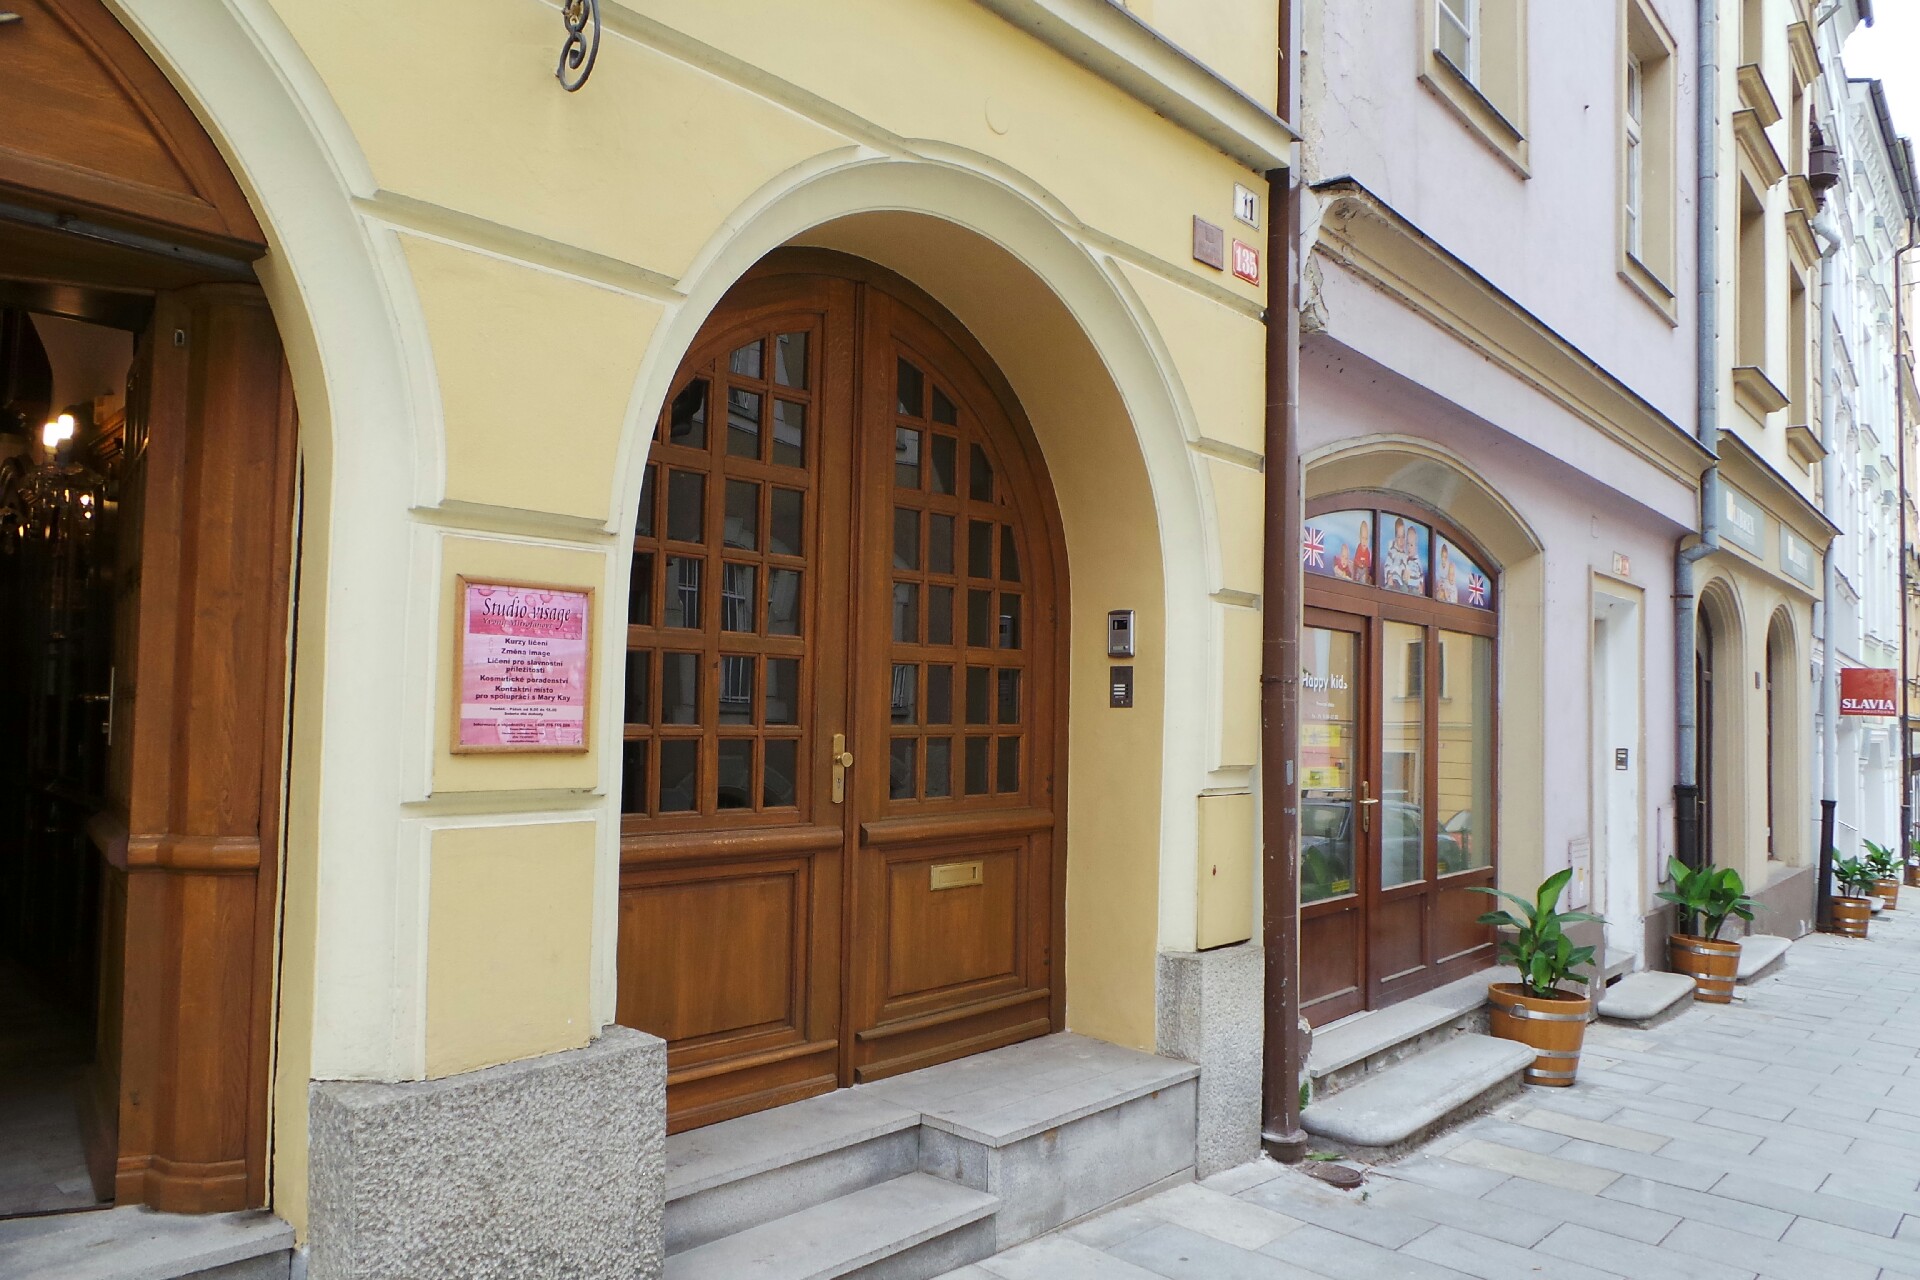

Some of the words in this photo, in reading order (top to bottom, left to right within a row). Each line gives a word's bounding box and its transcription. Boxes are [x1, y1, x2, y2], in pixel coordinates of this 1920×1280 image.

[1236, 246, 1258, 279] 135
[483, 596, 528, 619] Studio
[533, 602, 571, 630] visage
[505, 638, 526, 646] Kurzy
[529, 649, 551, 657] image
[1303, 672, 1329, 692] Happy
[1331, 673, 1348, 689] kids
[538, 694, 556, 702] Mary
[557, 694, 571, 702] Kay
[1842, 698, 1895, 710] SLAVIA
